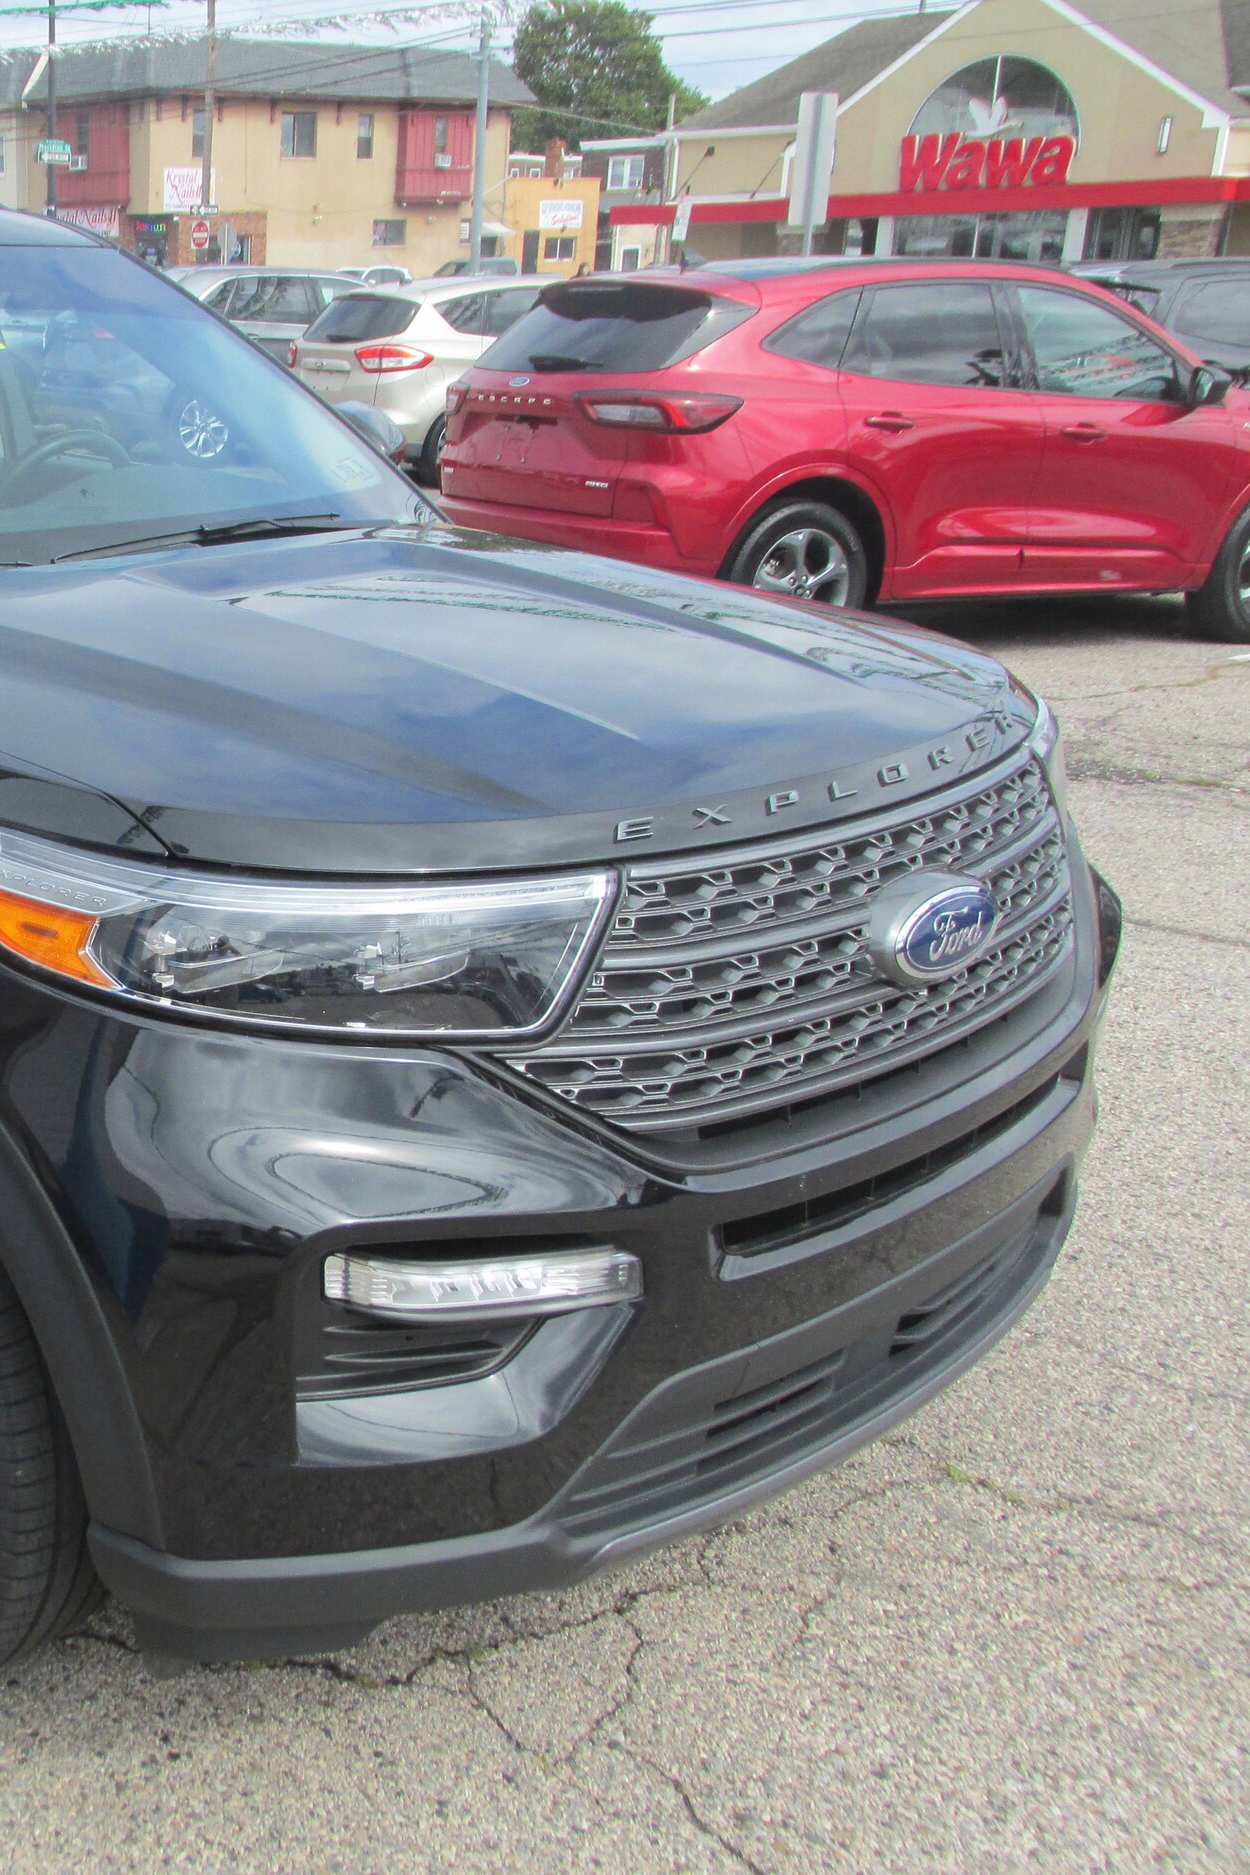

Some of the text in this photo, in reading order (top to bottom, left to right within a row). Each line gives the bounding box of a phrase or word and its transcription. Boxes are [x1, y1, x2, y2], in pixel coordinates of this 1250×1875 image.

[166, 169, 198, 186] Krystal
[899, 131, 1077, 193] Wawa
[169, 184, 195, 203] Nails
[78, 207, 108, 229] Nails
[613, 711, 1016, 845] EXPLORER
[929, 906, 983, 962] Ford
